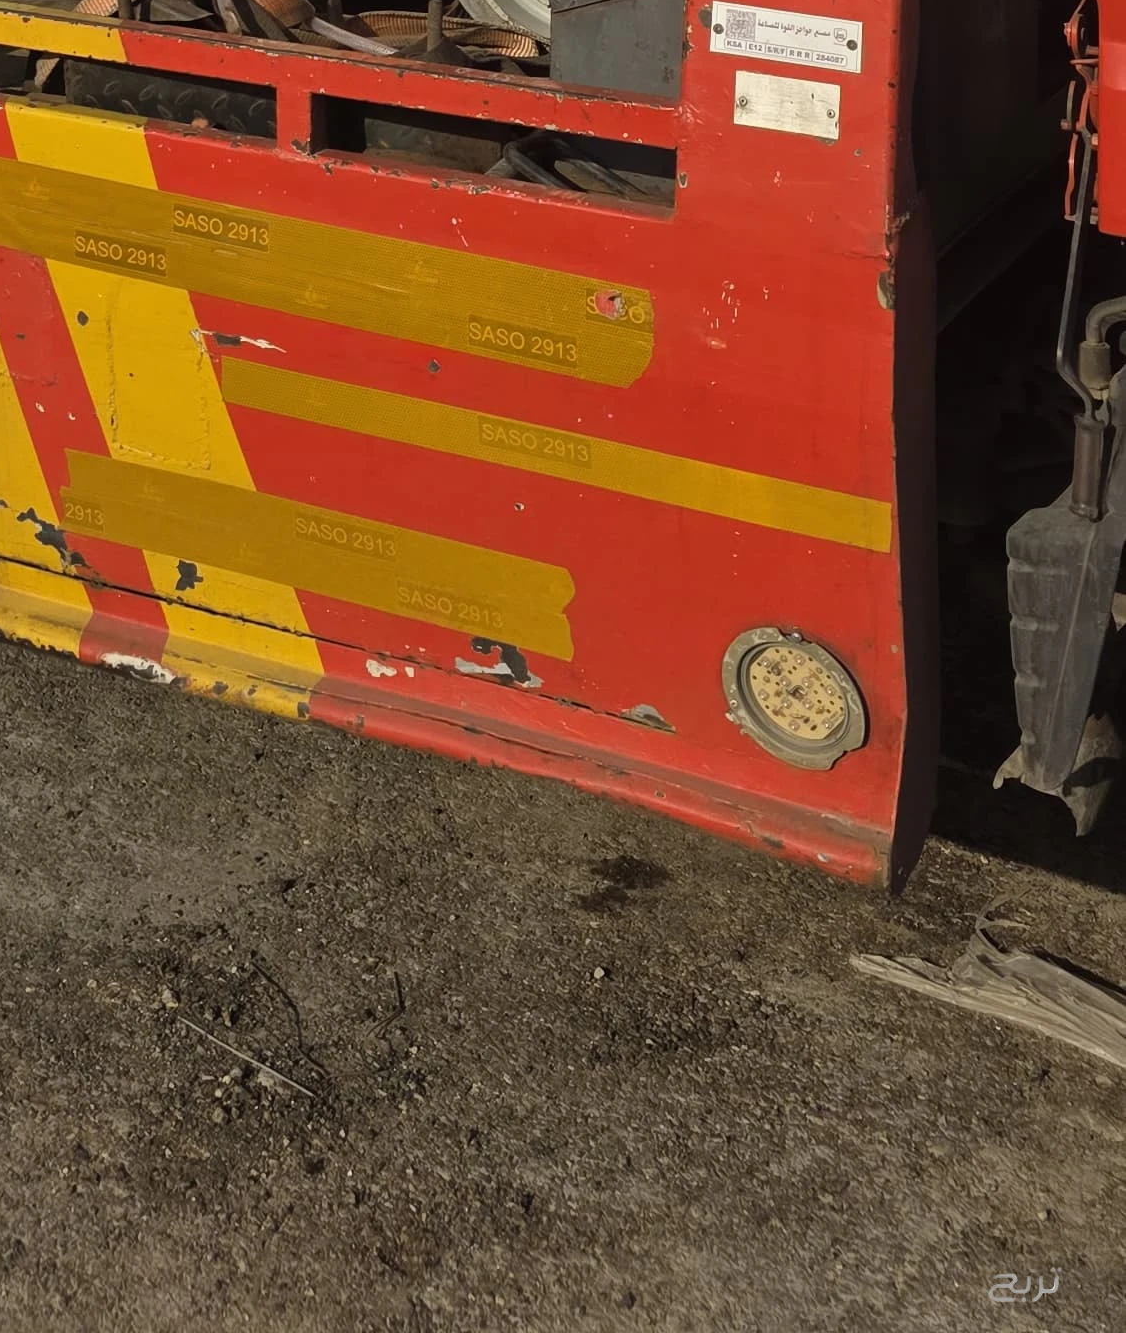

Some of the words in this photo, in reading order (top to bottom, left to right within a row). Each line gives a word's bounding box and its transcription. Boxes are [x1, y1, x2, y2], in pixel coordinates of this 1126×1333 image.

[173, 209, 224, 236] SASO
[227, 221, 270, 246] 2913
[73, 235, 123, 261] SASO
[126, 246, 167, 271] 2913
[585, 296, 645, 324] SO
[468, 322, 526, 350] SASO
[530, 336, 577, 362] 2913
[481, 423, 538, 450] SASO
[543, 437, 589, 463] 2913
[64, 502, 105, 526] 2913
[295, 517, 348, 544] SASO
[353, 532, 396, 558] 2913
[397, 586, 453, 615] SASO
[457, 603, 504, 629] 2913
